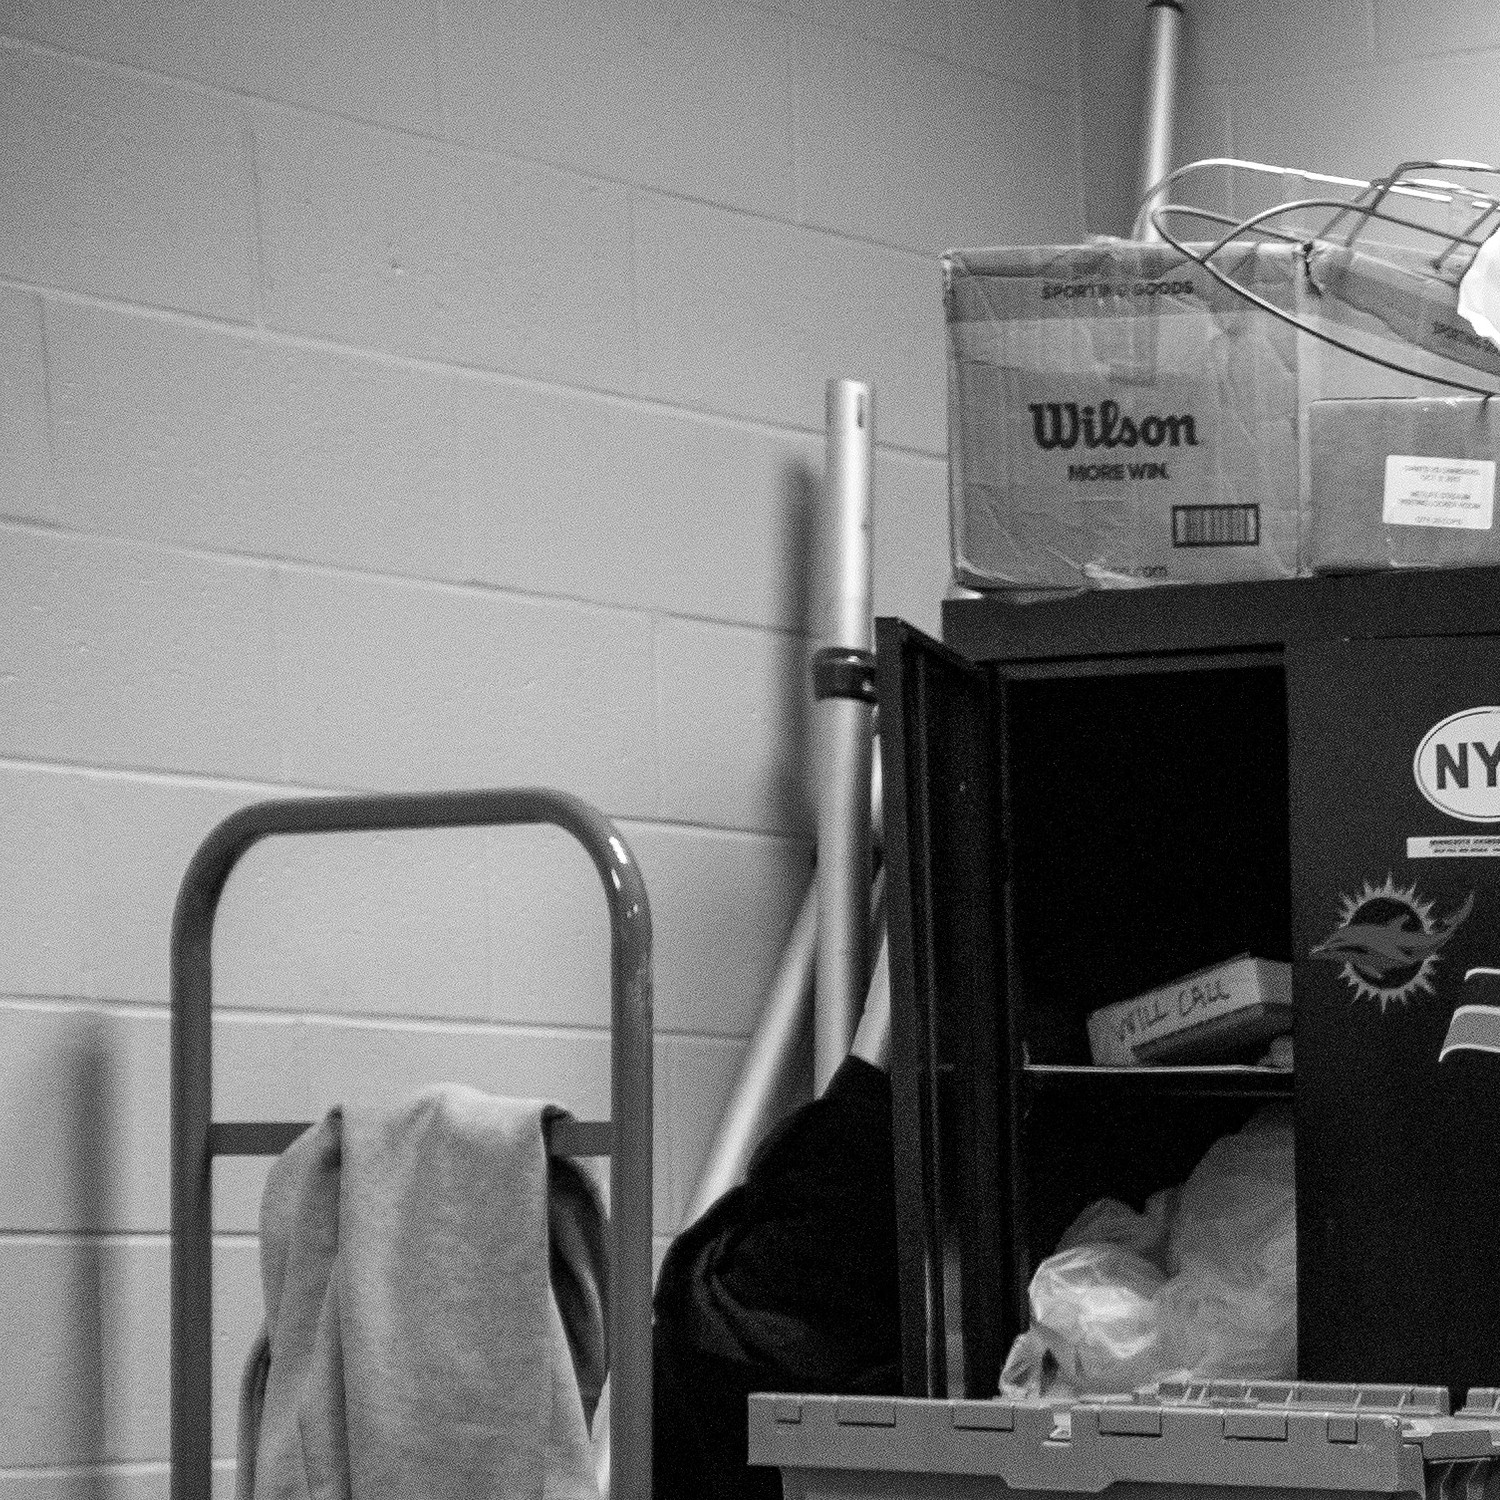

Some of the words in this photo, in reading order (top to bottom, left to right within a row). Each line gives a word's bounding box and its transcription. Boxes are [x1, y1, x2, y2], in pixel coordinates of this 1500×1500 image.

[1132, 280, 1194, 296] GOODS
[1028, 399, 1199, 451] Wilson
[1068, 464, 1124, 481] MORE
[1178, 980, 1231, 1017] CALL
